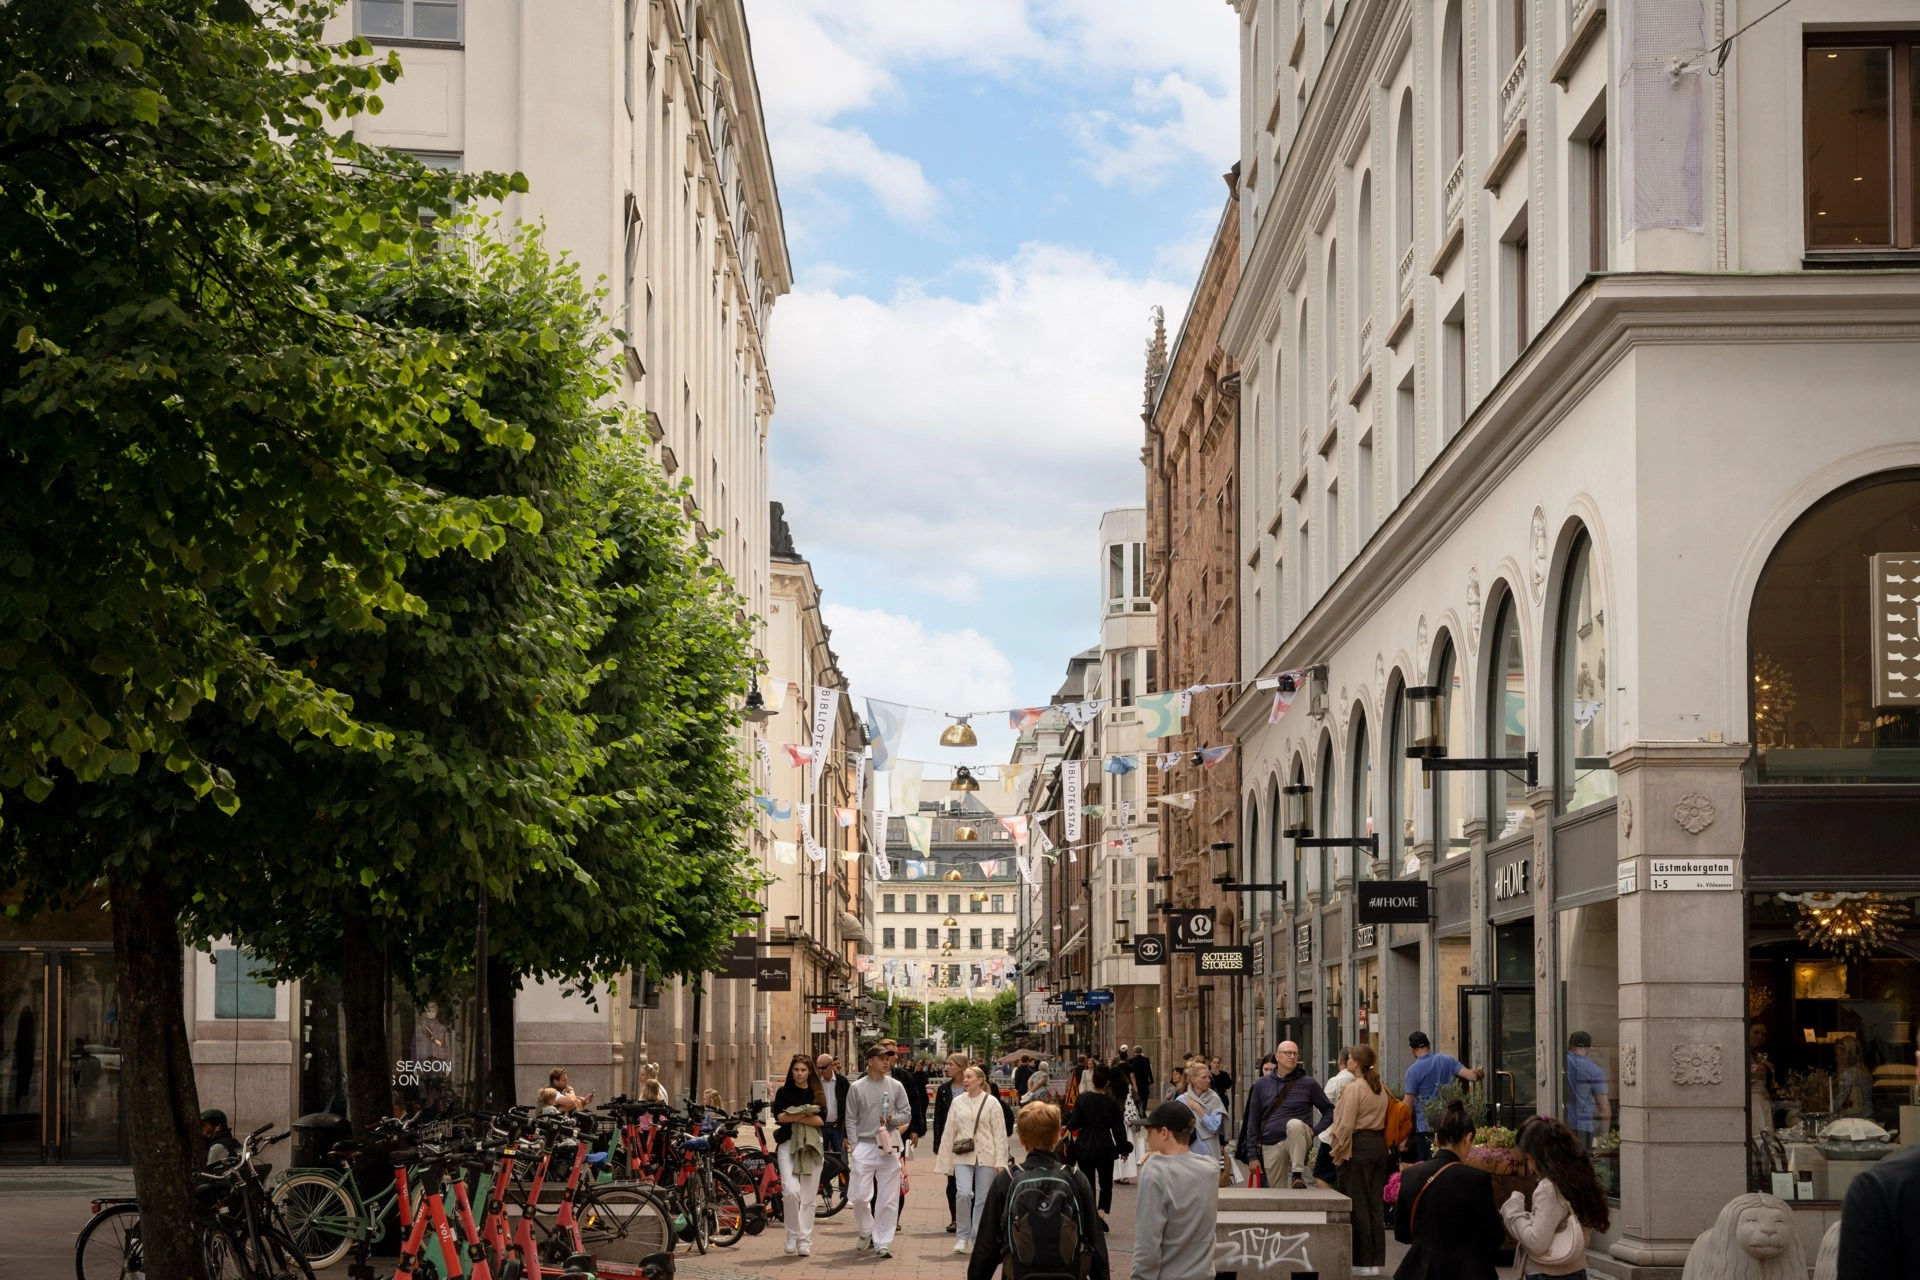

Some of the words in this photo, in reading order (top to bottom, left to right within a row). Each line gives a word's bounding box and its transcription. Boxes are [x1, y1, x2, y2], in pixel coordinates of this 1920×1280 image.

[814, 689, 831, 763] BIBLIOTE
[1065, 760, 1077, 836] BIBLIOTEKSTAN
[1654, 862, 1729, 875] Lästmakargatan
[1654, 880, 1668, 889] 1-5
[1384, 896, 1419, 908] HOME
[1202, 952, 1243, 961] &OTHER
[1202, 961, 1243, 970] STORIES
[396, 1060, 452, 1072] SEASON
[398, 1074, 419, 1086] ON
[439, 1222, 448, 1243] voi.
